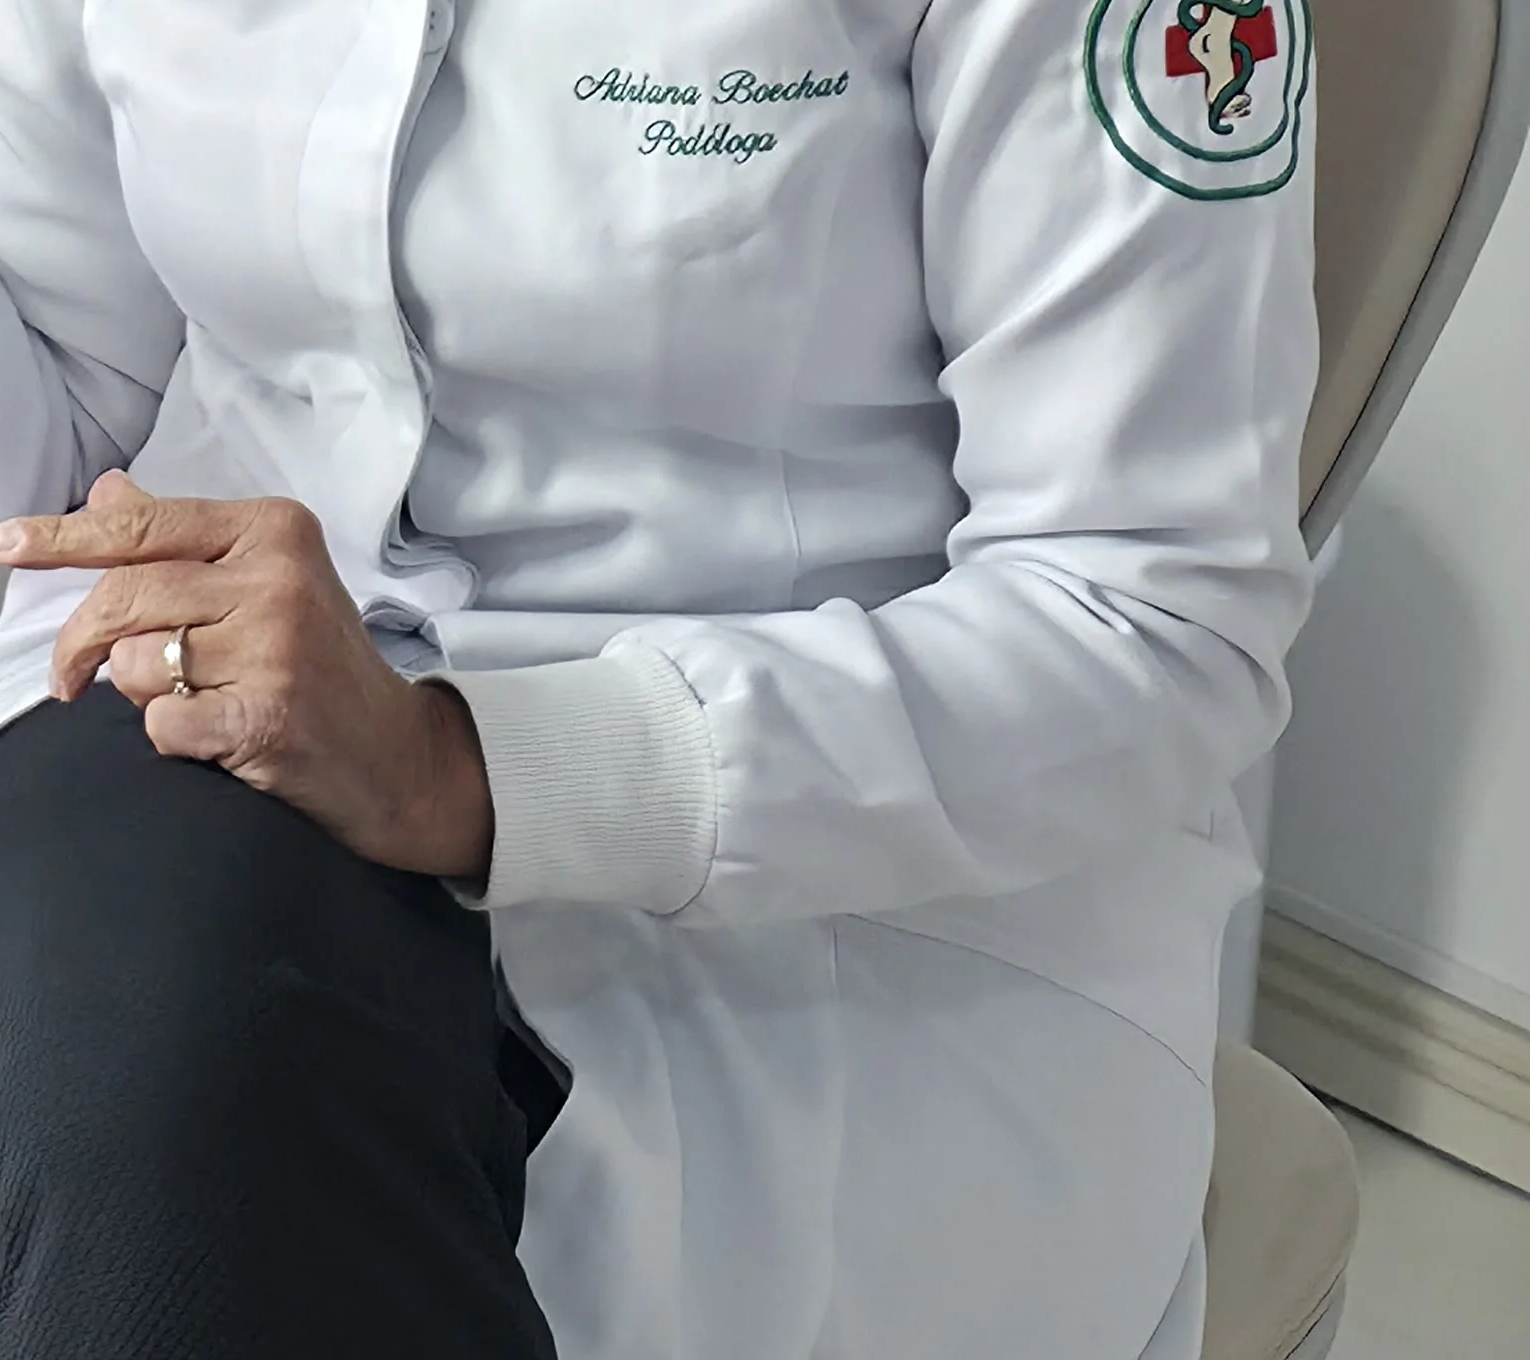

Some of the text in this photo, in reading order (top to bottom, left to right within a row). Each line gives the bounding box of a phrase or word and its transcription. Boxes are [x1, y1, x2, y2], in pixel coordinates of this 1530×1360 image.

[574, 68, 850, 106] Adriana Boechat
[639, 120, 778, 164] Podóloga
